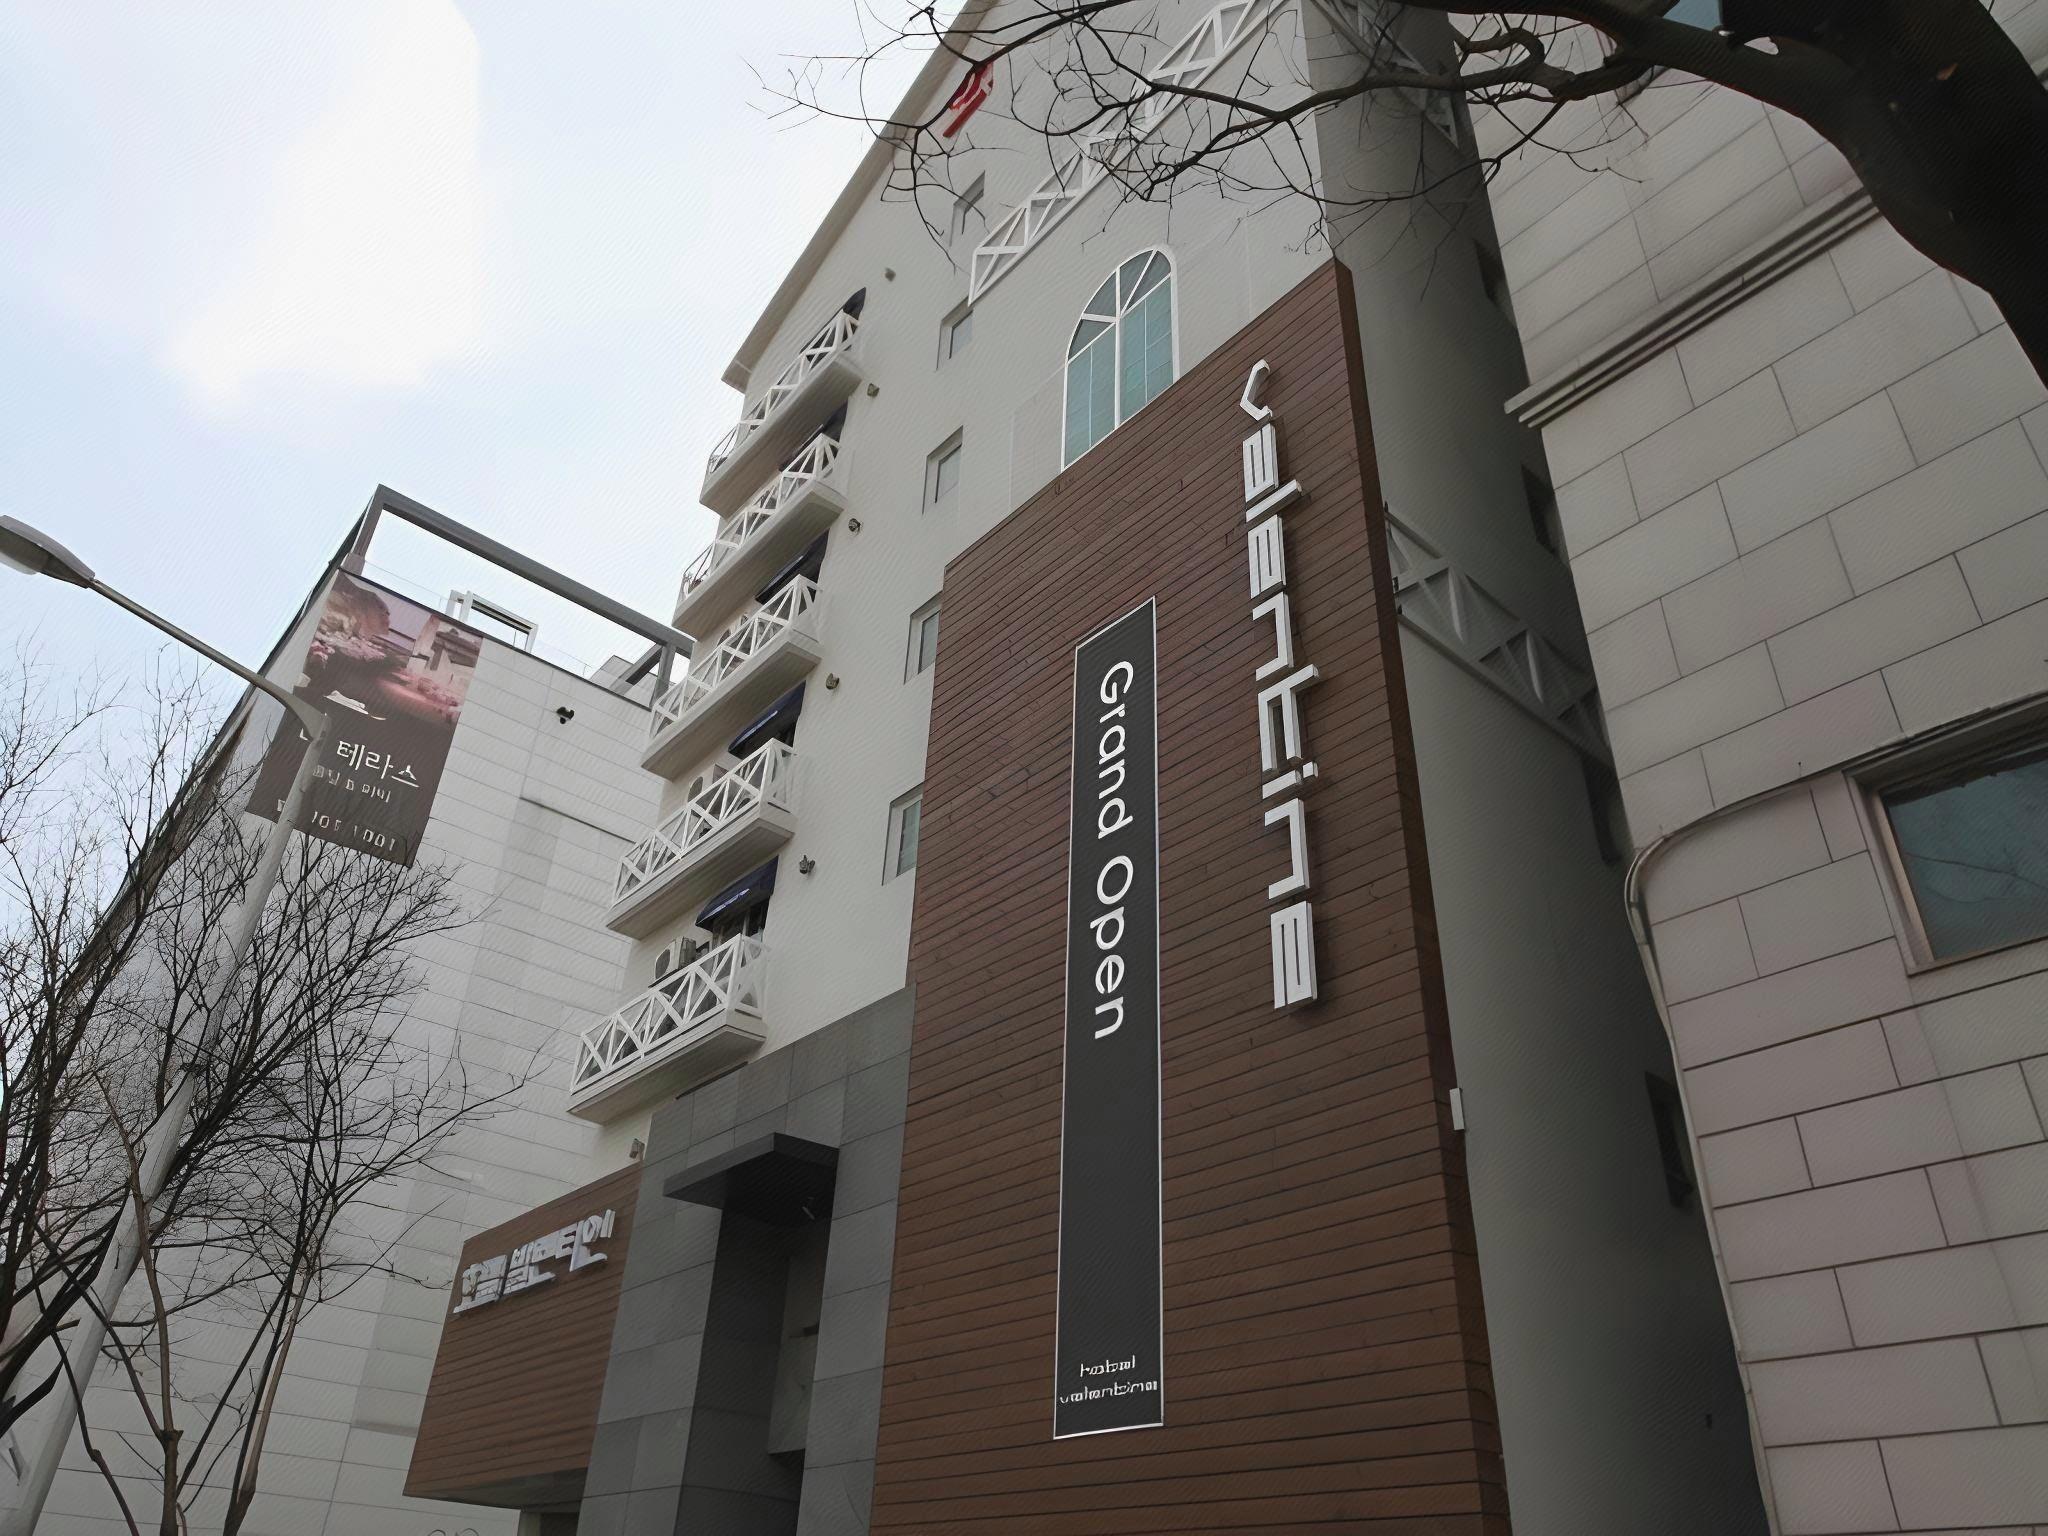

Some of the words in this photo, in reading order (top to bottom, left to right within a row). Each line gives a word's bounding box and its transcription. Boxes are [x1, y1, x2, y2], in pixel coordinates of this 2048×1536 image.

[336, 740, 420, 788] 테라스
[1097, 660, 1134, 840] Grand
[1089, 855, 1134, 1040] Open
